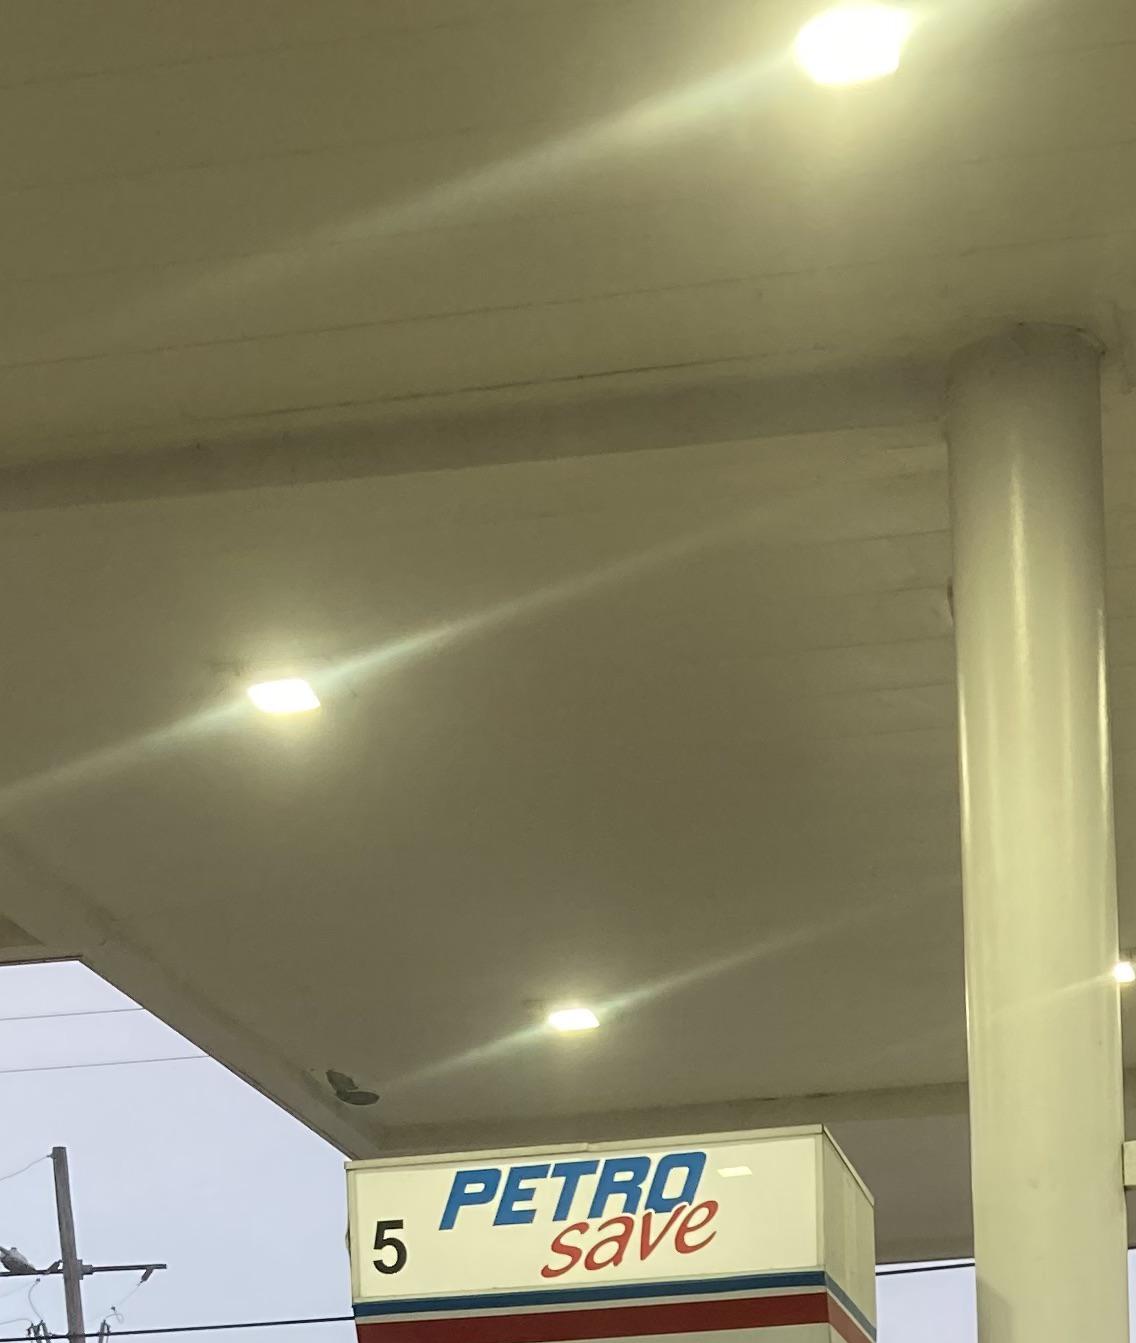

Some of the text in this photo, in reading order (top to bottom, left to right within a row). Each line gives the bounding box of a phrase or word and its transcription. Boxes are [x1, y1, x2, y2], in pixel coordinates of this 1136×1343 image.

[438, 1151, 707, 1231] PETRO
[372, 1219, 407, 1275] 5
[540, 1199, 719, 1279] save
